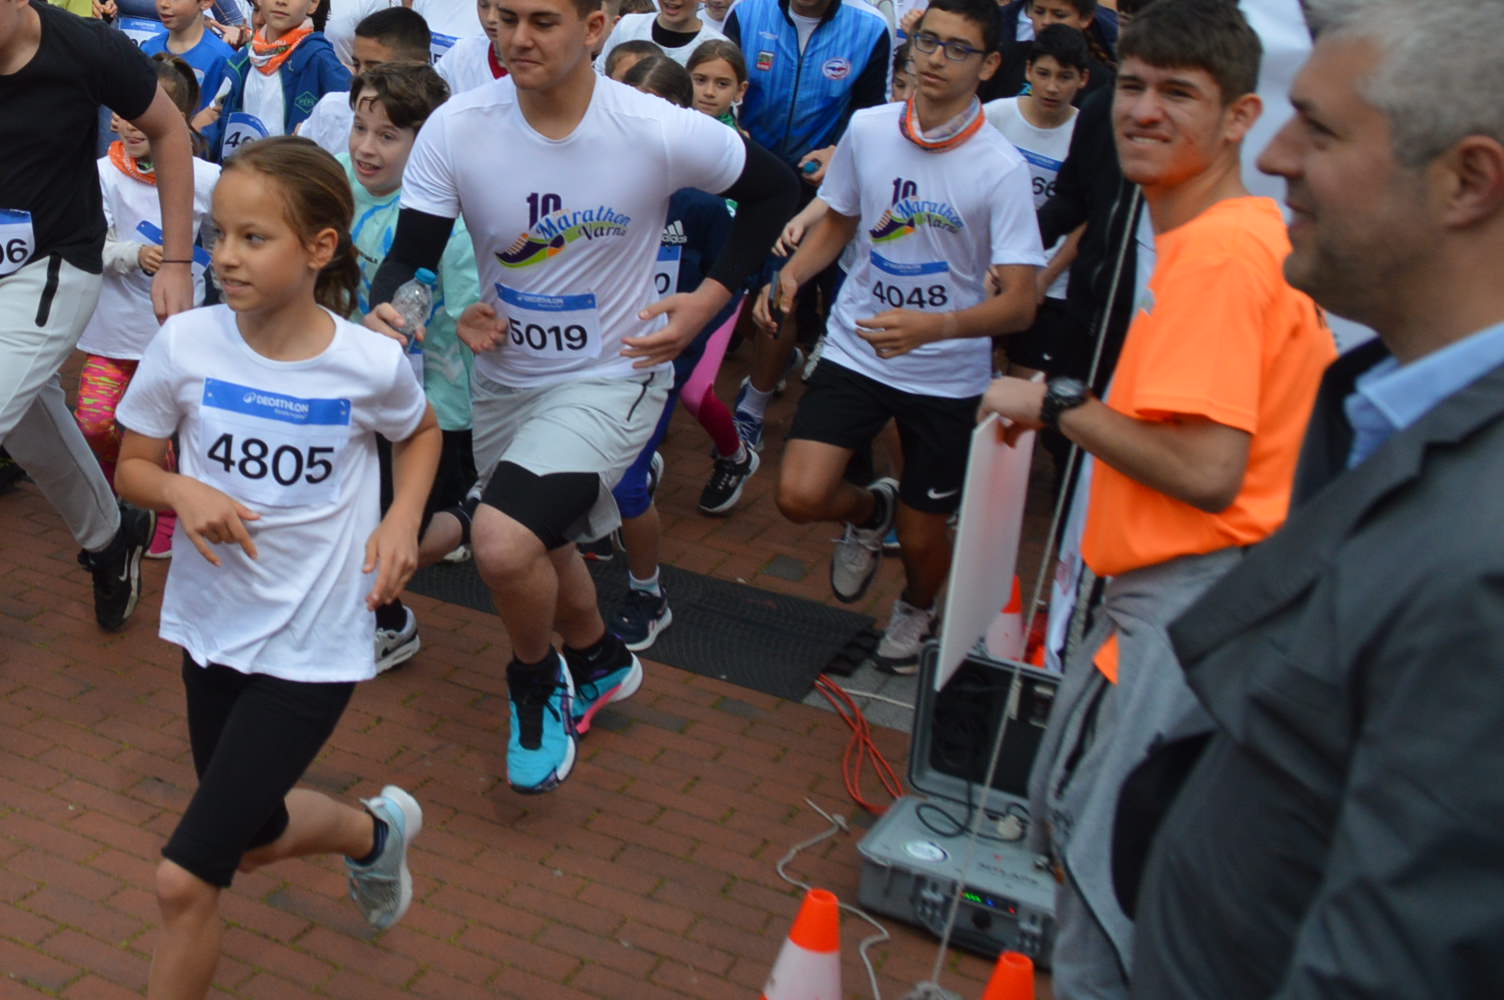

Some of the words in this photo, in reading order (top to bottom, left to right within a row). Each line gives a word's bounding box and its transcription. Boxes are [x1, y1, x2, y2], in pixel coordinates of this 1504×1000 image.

[526, 192, 562, 231] 10
[536, 206, 632, 241] Marathon
[578, 225, 627, 241] Varna
[872, 280, 948, 309] 4048
[509, 317, 588, 351] 5019
[256, 395, 310, 413] DECATHLON
[207, 432, 334, 487] 4805
